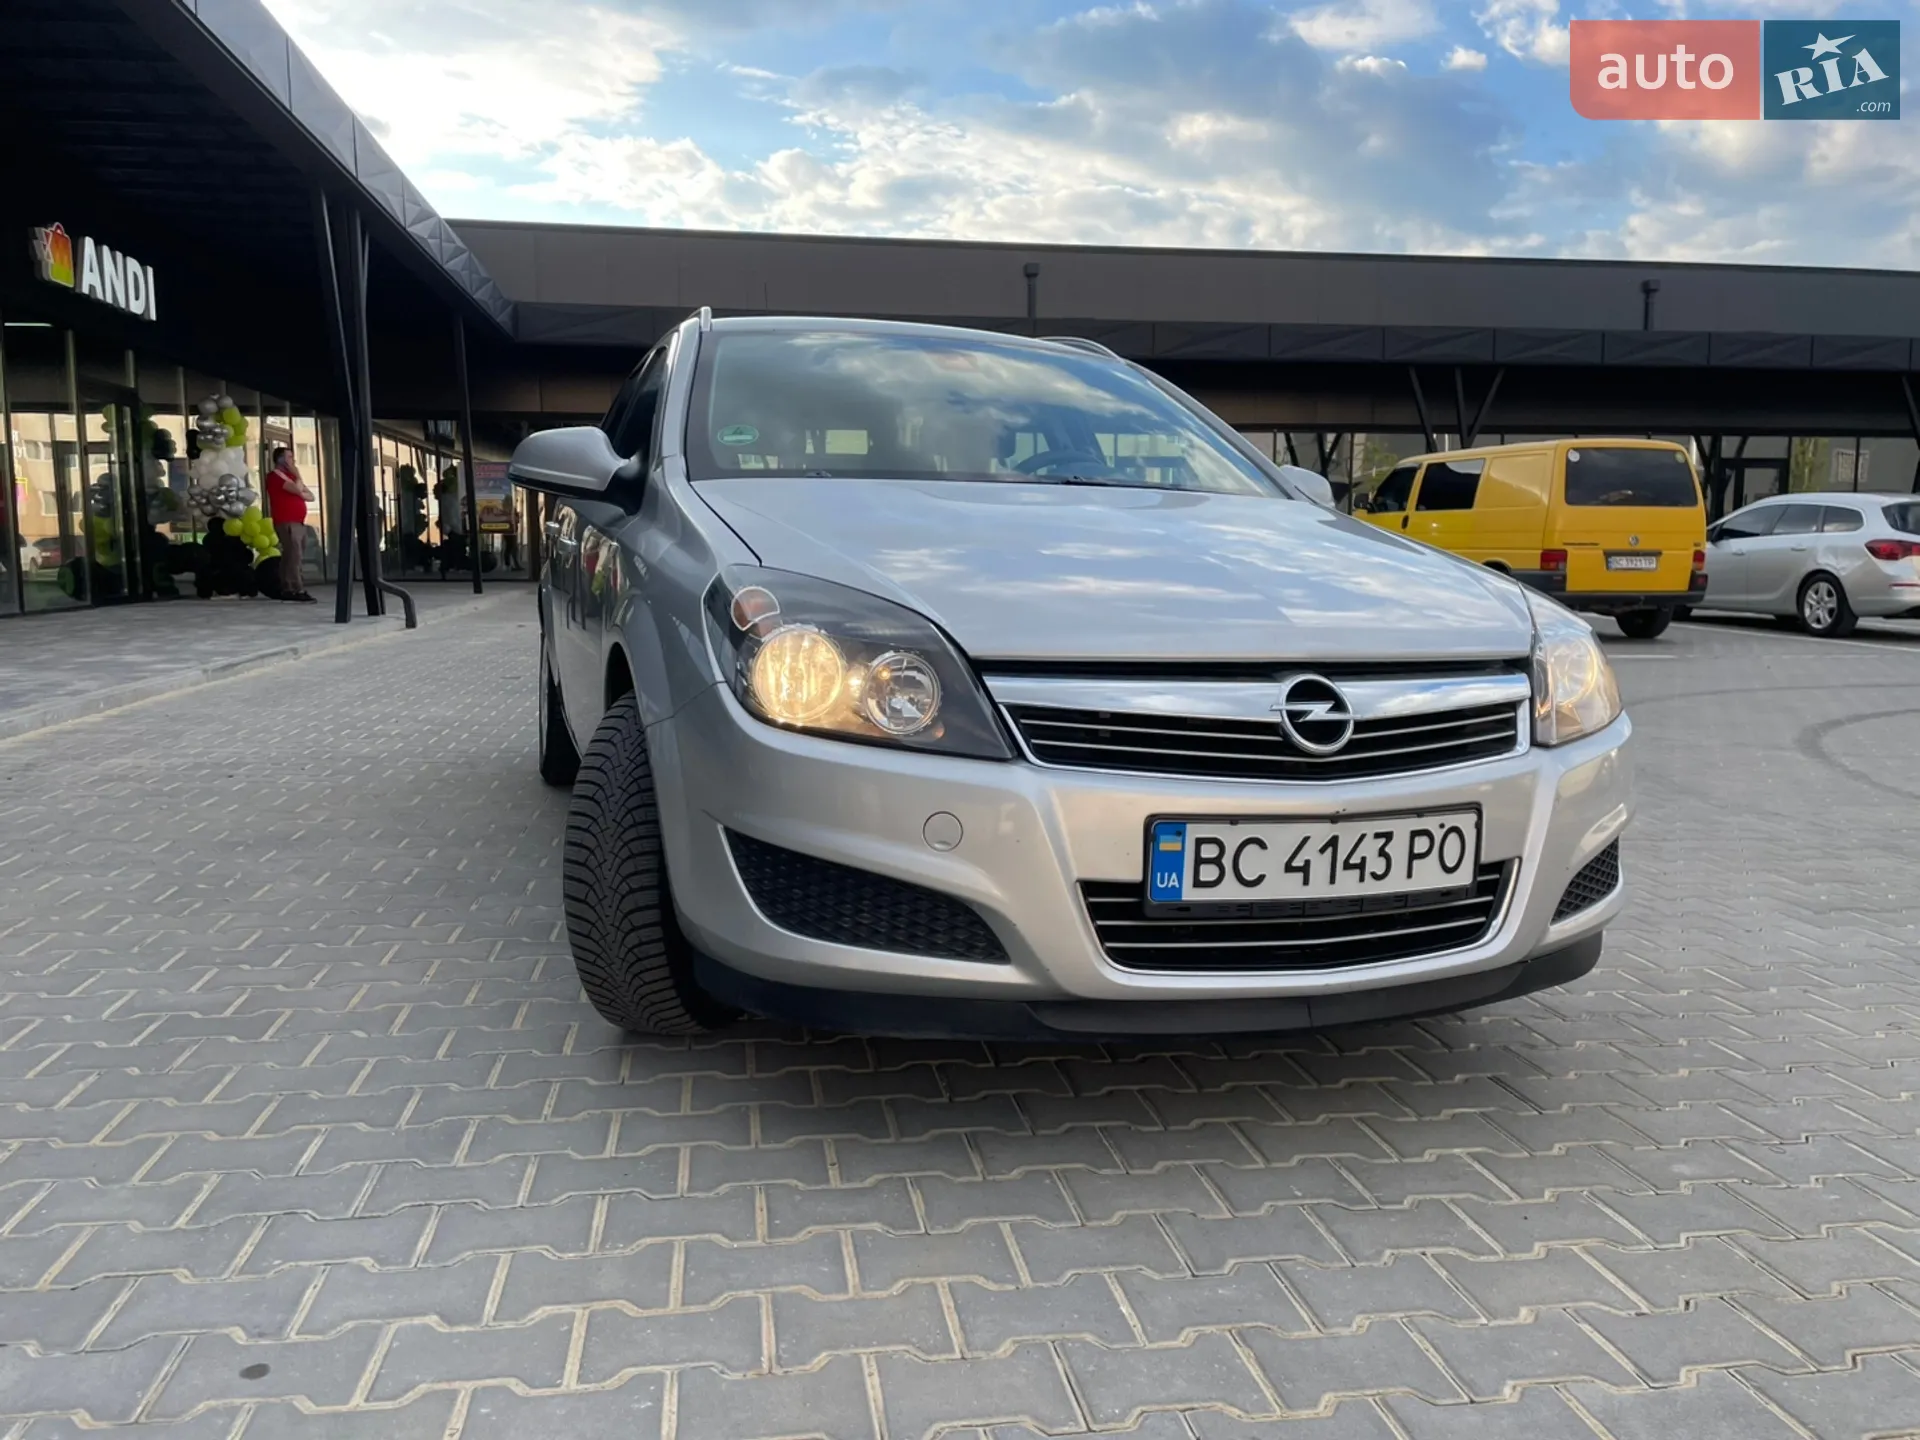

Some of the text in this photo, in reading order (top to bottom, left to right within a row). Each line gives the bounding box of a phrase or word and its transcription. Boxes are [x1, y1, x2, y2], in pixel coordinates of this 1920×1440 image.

[79, 235, 157, 321] ANDI
[1156, 872, 1180, 889] UA
[1192, 825, 1466, 889] BC 4143 PO
